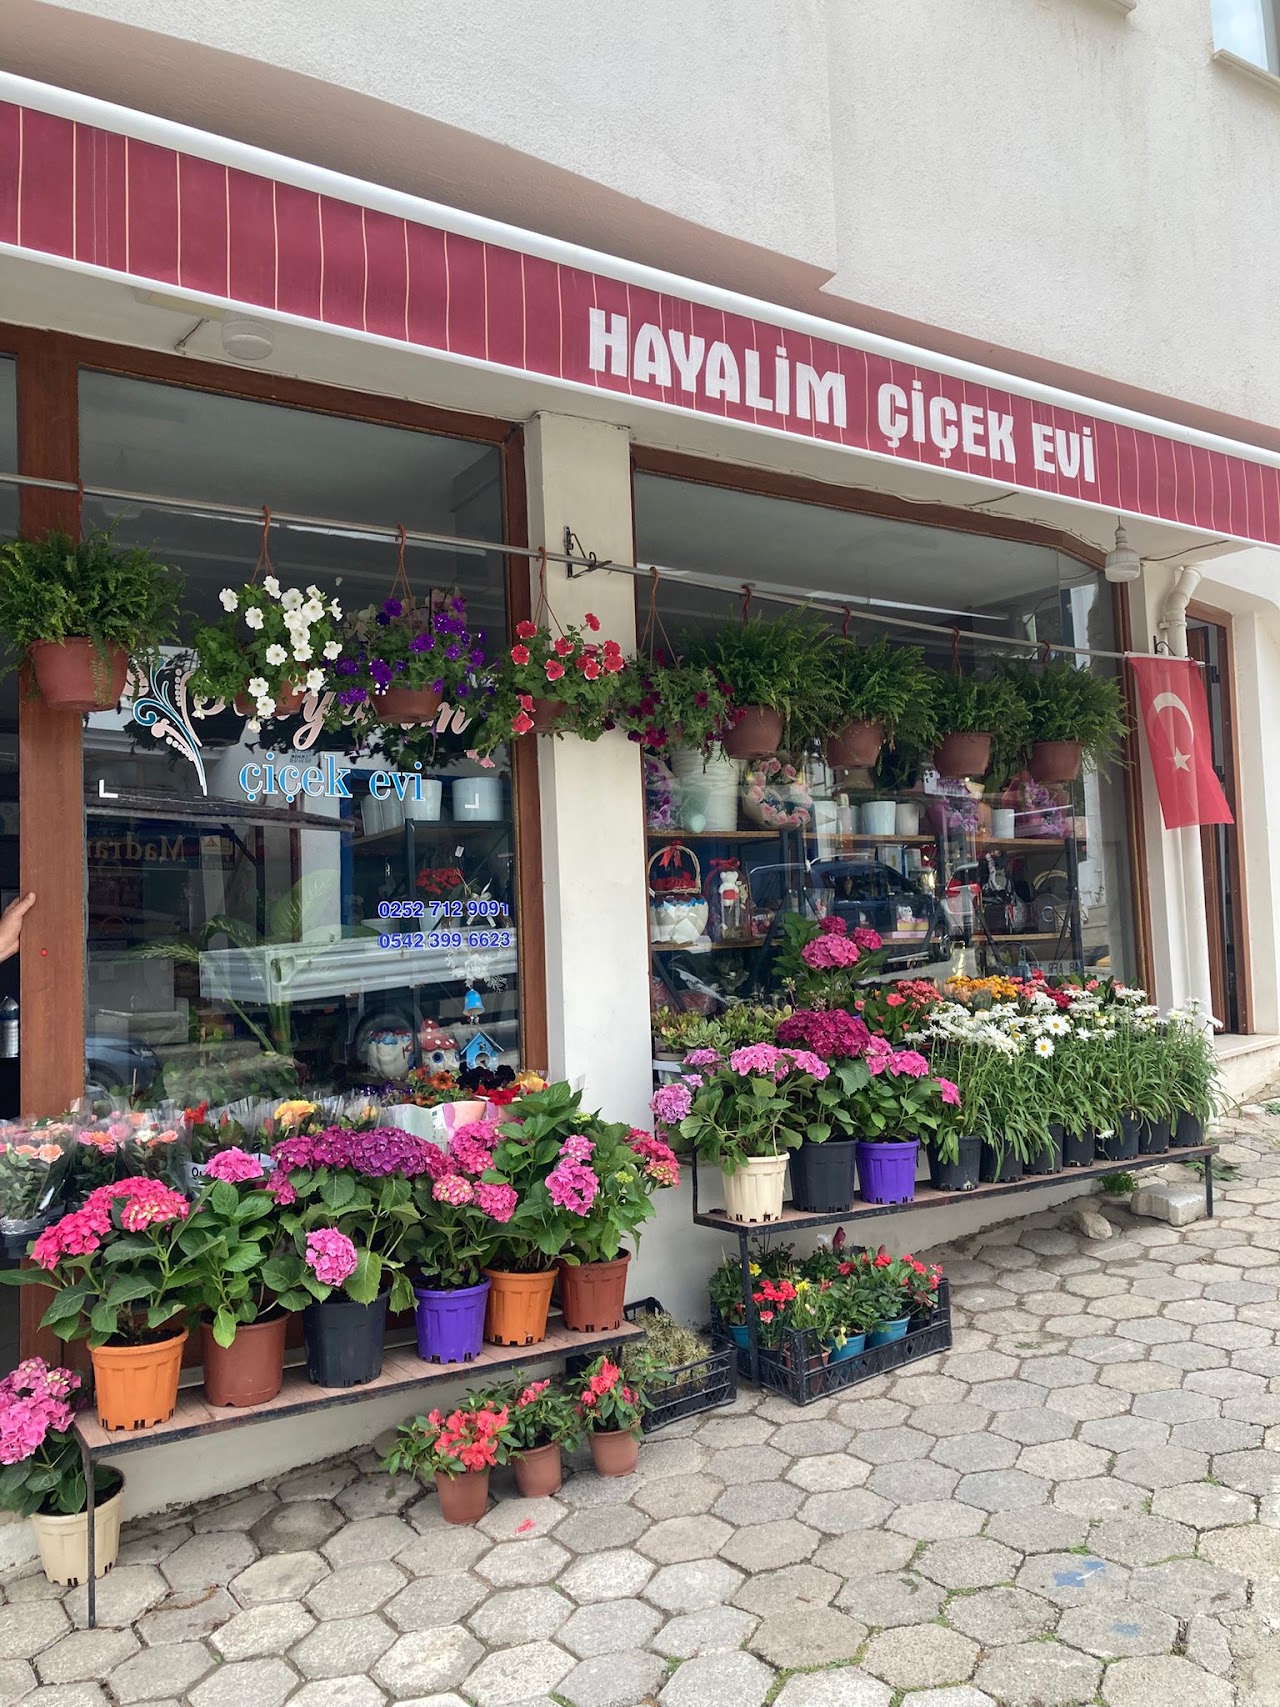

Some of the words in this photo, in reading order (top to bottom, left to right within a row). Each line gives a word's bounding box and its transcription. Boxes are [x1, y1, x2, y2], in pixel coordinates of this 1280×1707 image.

[589, 307, 846, 429] HAYALİM
[878, 380, 1016, 465] ÇİÇEK
[1032, 422, 1096, 484] EVİ
[239, 752, 352, 803] çiçek
[368, 761, 426, 802] evi
[378, 901, 425, 918] 0252
[429, 901, 463, 918] 712
[467, 900, 510, 917] 9091
[379, 933, 424, 949] 0542
[429, 932, 462, 948] 399
[469, 931, 511, 948] 6623
